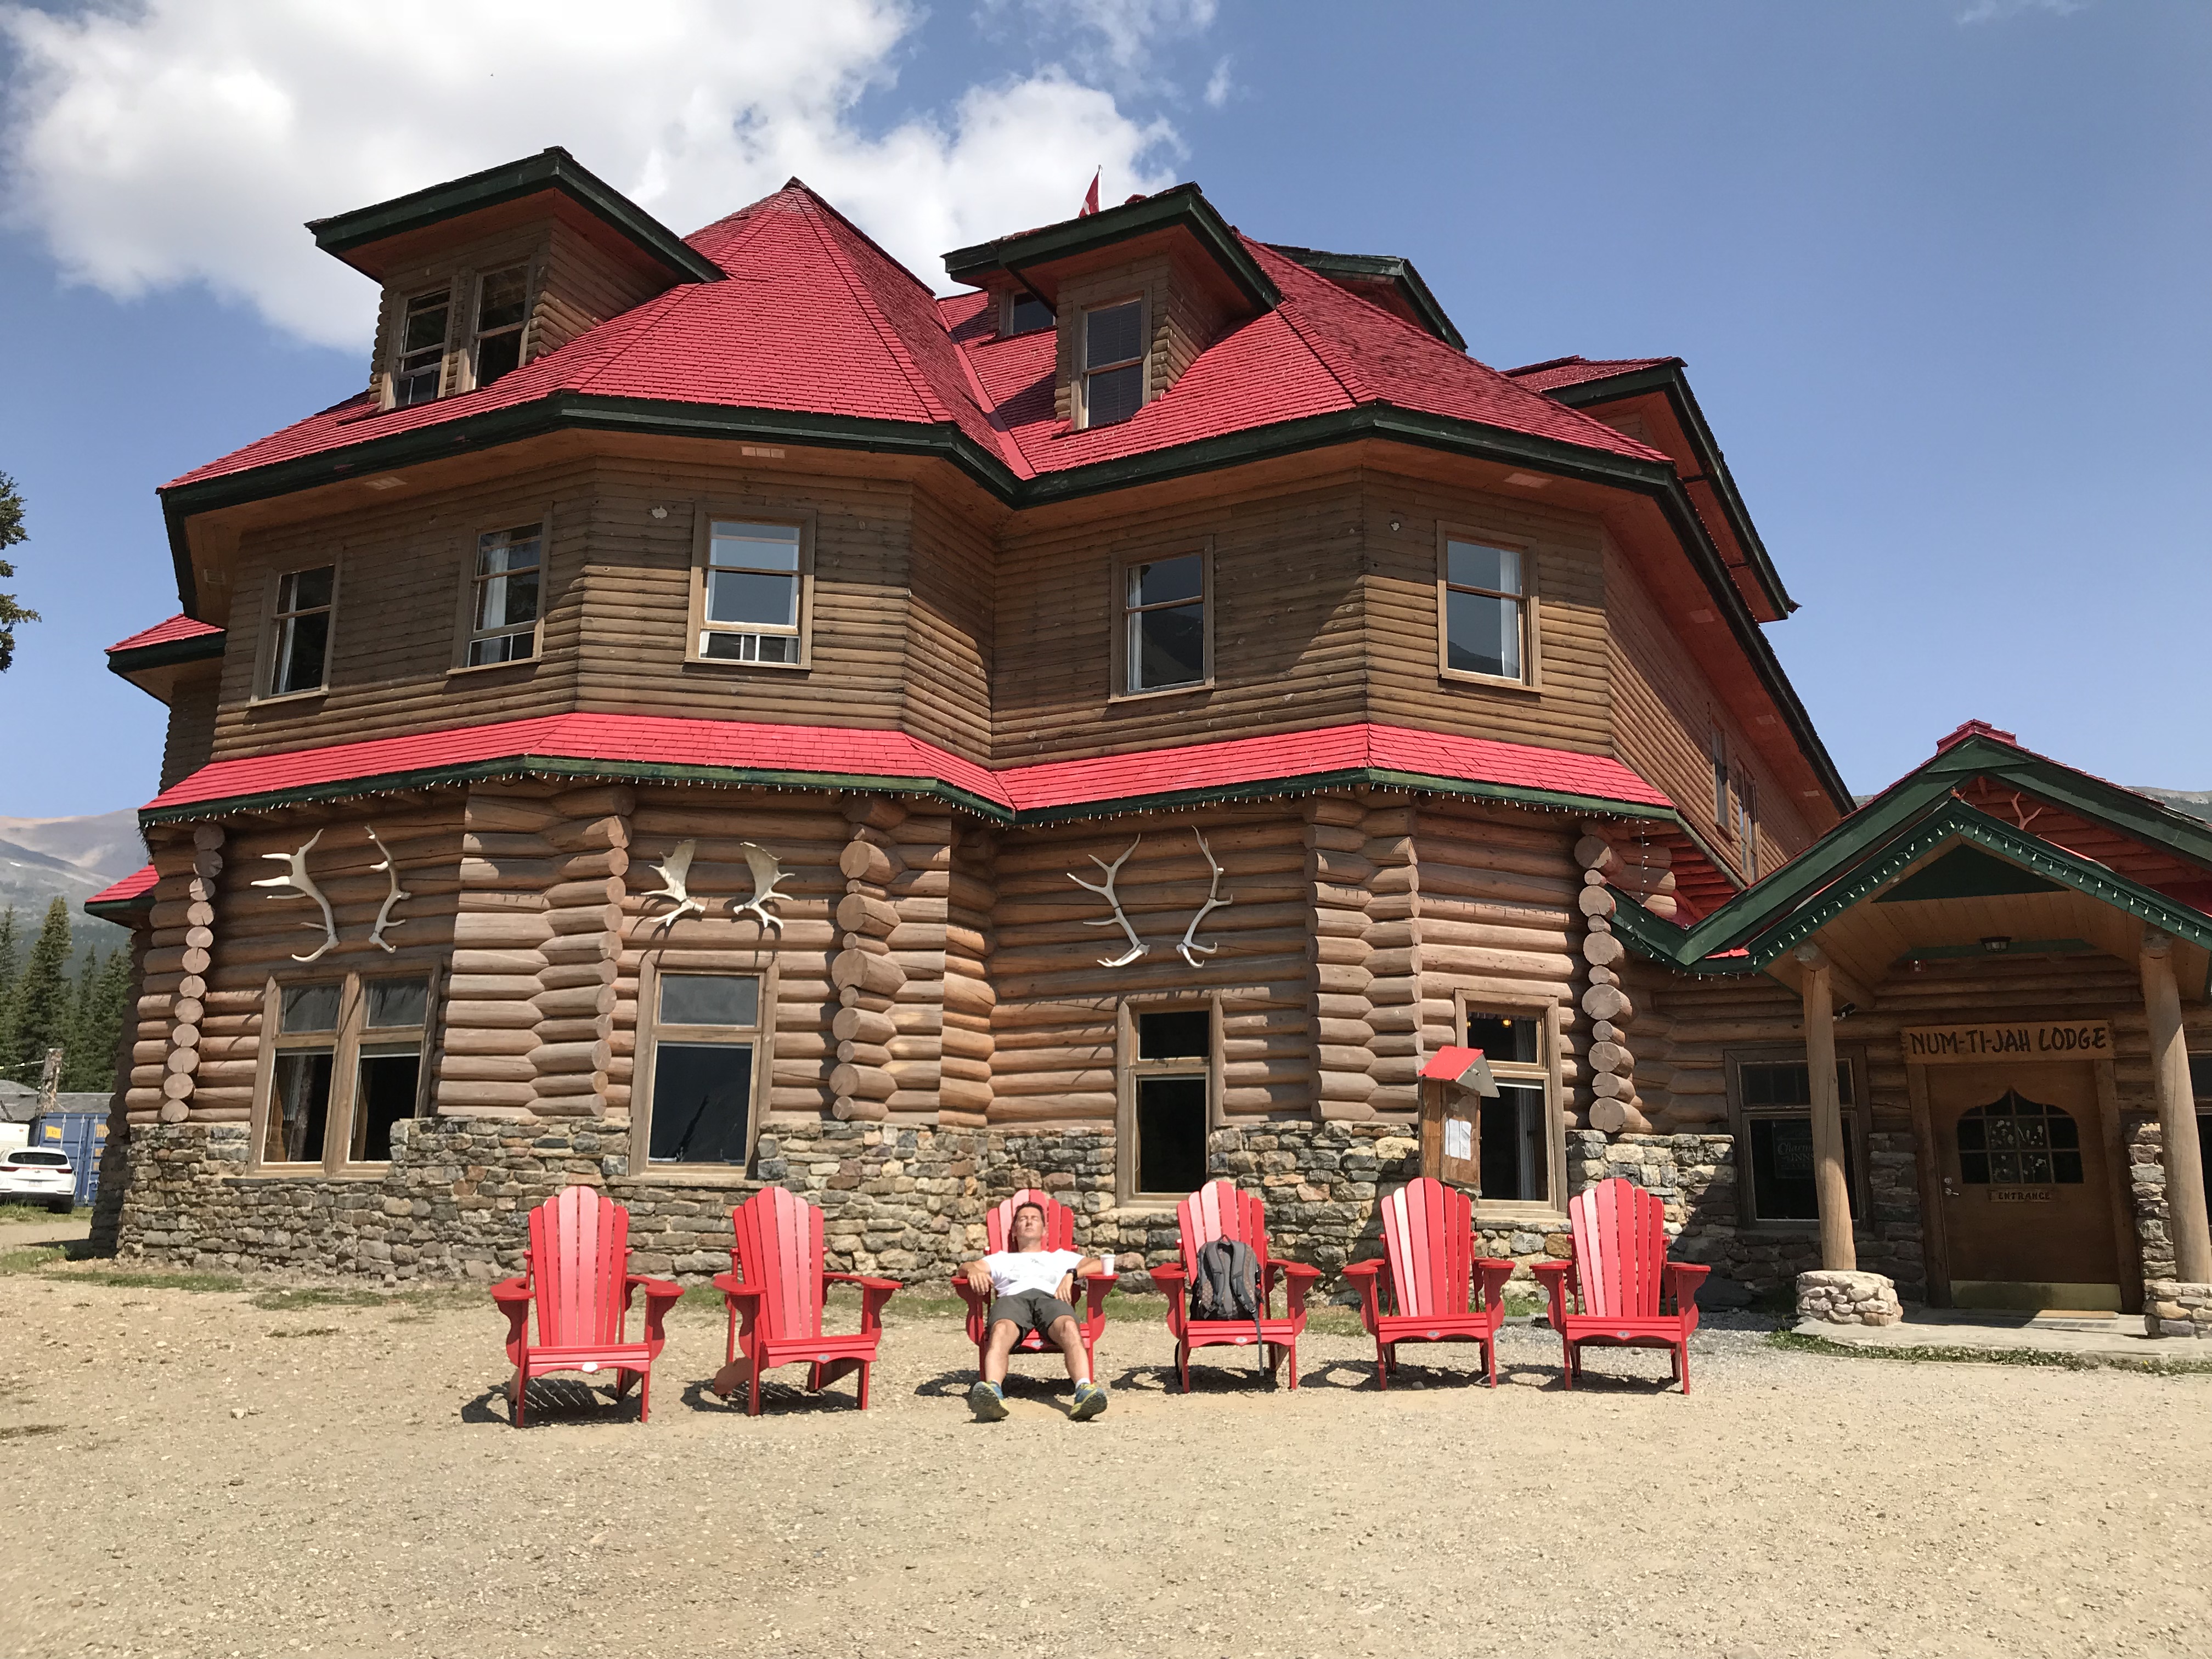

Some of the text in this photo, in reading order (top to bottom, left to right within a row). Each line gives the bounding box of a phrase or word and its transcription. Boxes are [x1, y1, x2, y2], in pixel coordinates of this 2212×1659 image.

[1909, 1027, 2106, 1055] NUM-TI-JAH LODGE
[1778, 1142, 1813, 1155] Charm
[1998, 1192, 2050, 1200] ENTRANCE
